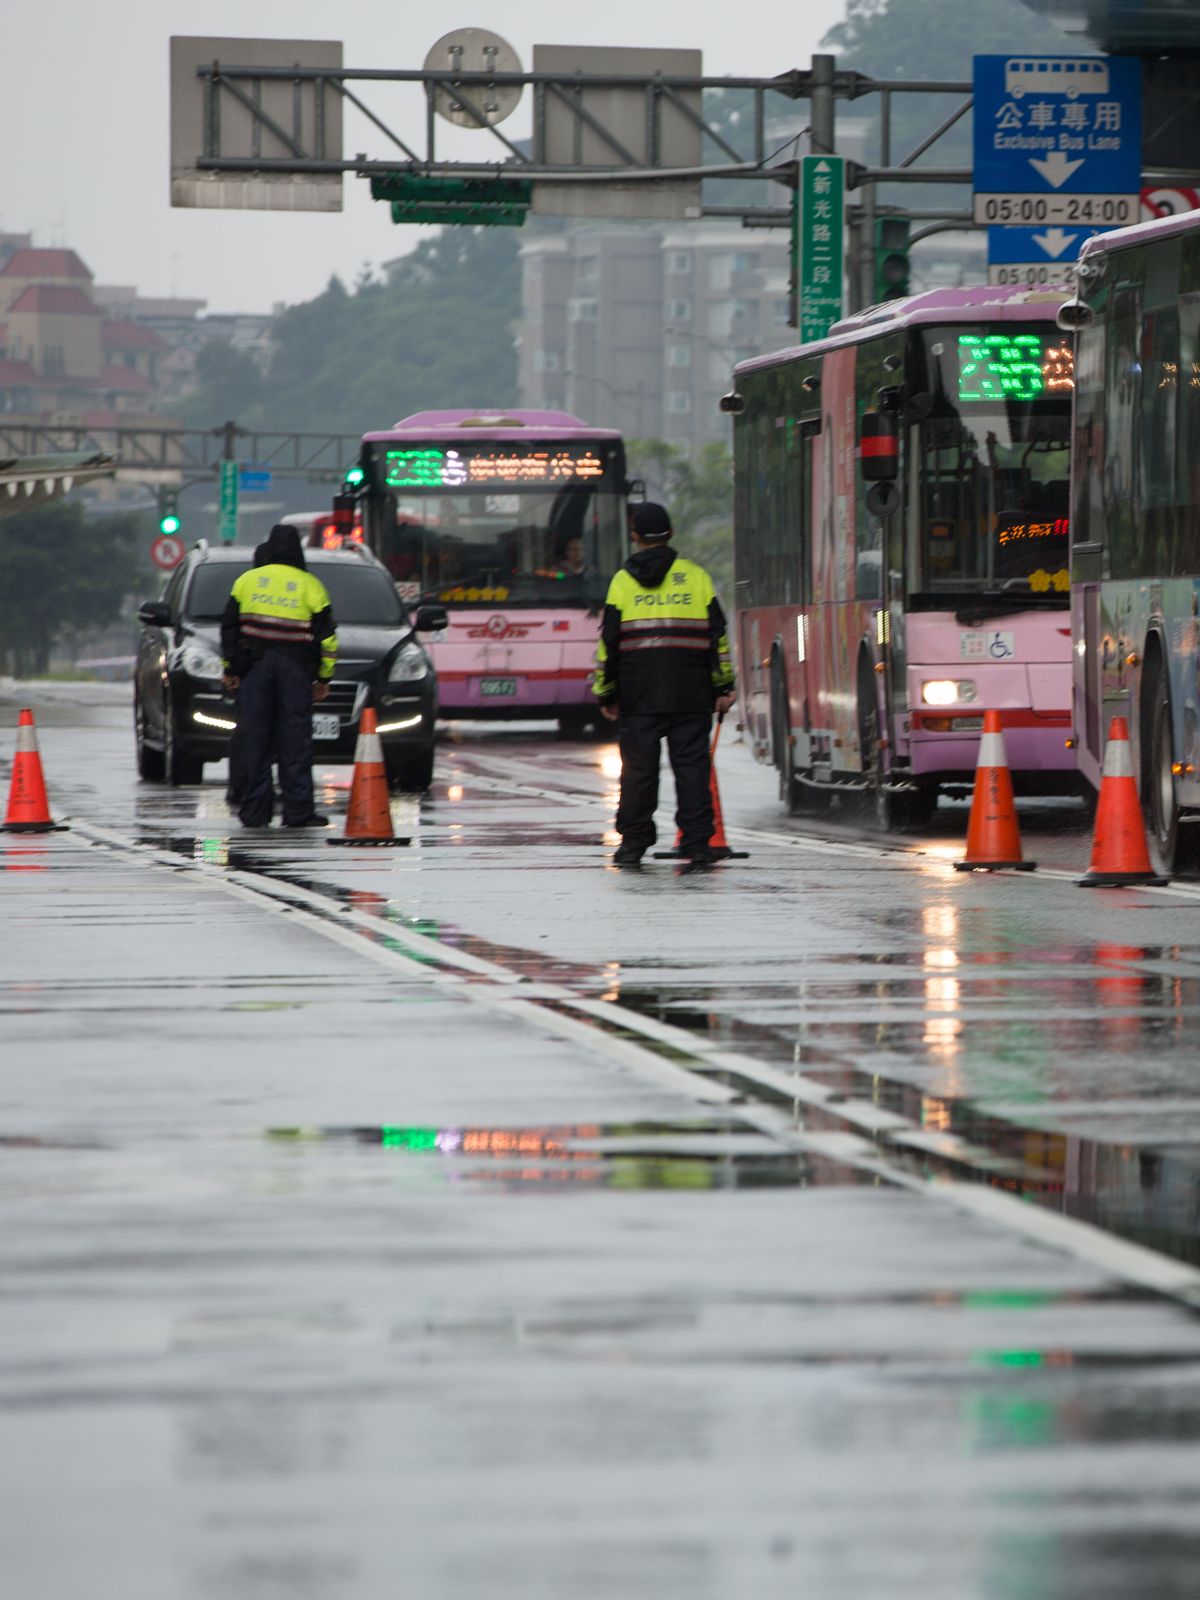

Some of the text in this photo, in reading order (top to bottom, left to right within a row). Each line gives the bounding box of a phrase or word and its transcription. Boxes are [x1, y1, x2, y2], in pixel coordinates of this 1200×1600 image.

[995, 102, 1121, 131] 公車專用
[994, 132, 1120, 150] Exclusive Bus Lane
[812, 175, 832, 284] 新光路二段
[672, 571, 687, 586] 察
[251, 593, 299, 609] POLICE
[634, 592, 692, 606] POLICE
